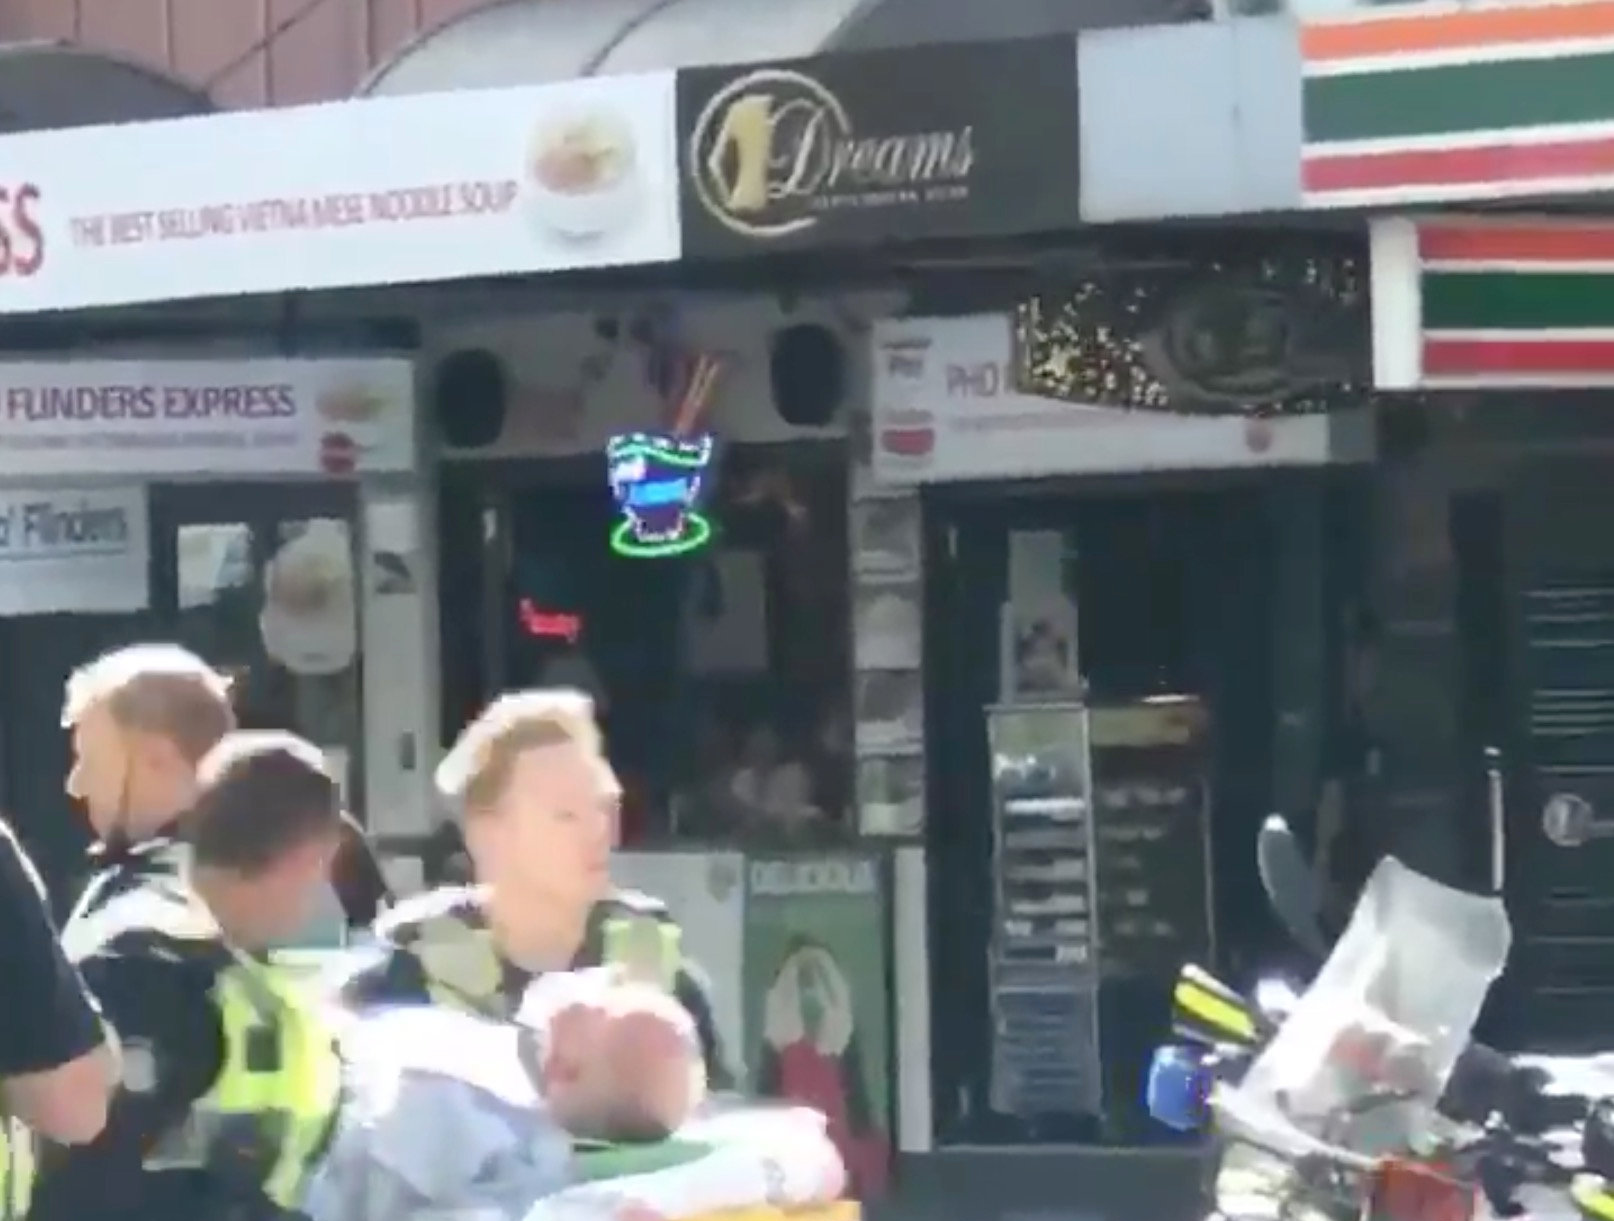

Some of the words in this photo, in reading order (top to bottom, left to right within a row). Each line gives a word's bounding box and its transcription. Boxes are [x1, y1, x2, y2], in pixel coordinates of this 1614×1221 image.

[69, 215, 104, 247] THE
[111, 211, 154, 244] BEST
[158, 203, 233, 239] SELLING
[369, 184, 452, 222] NOODLE
[460, 179, 519, 214] SOUP
[6, 384, 156, 421] FLINDERS
[162, 383, 297, 419] EXPRESS
